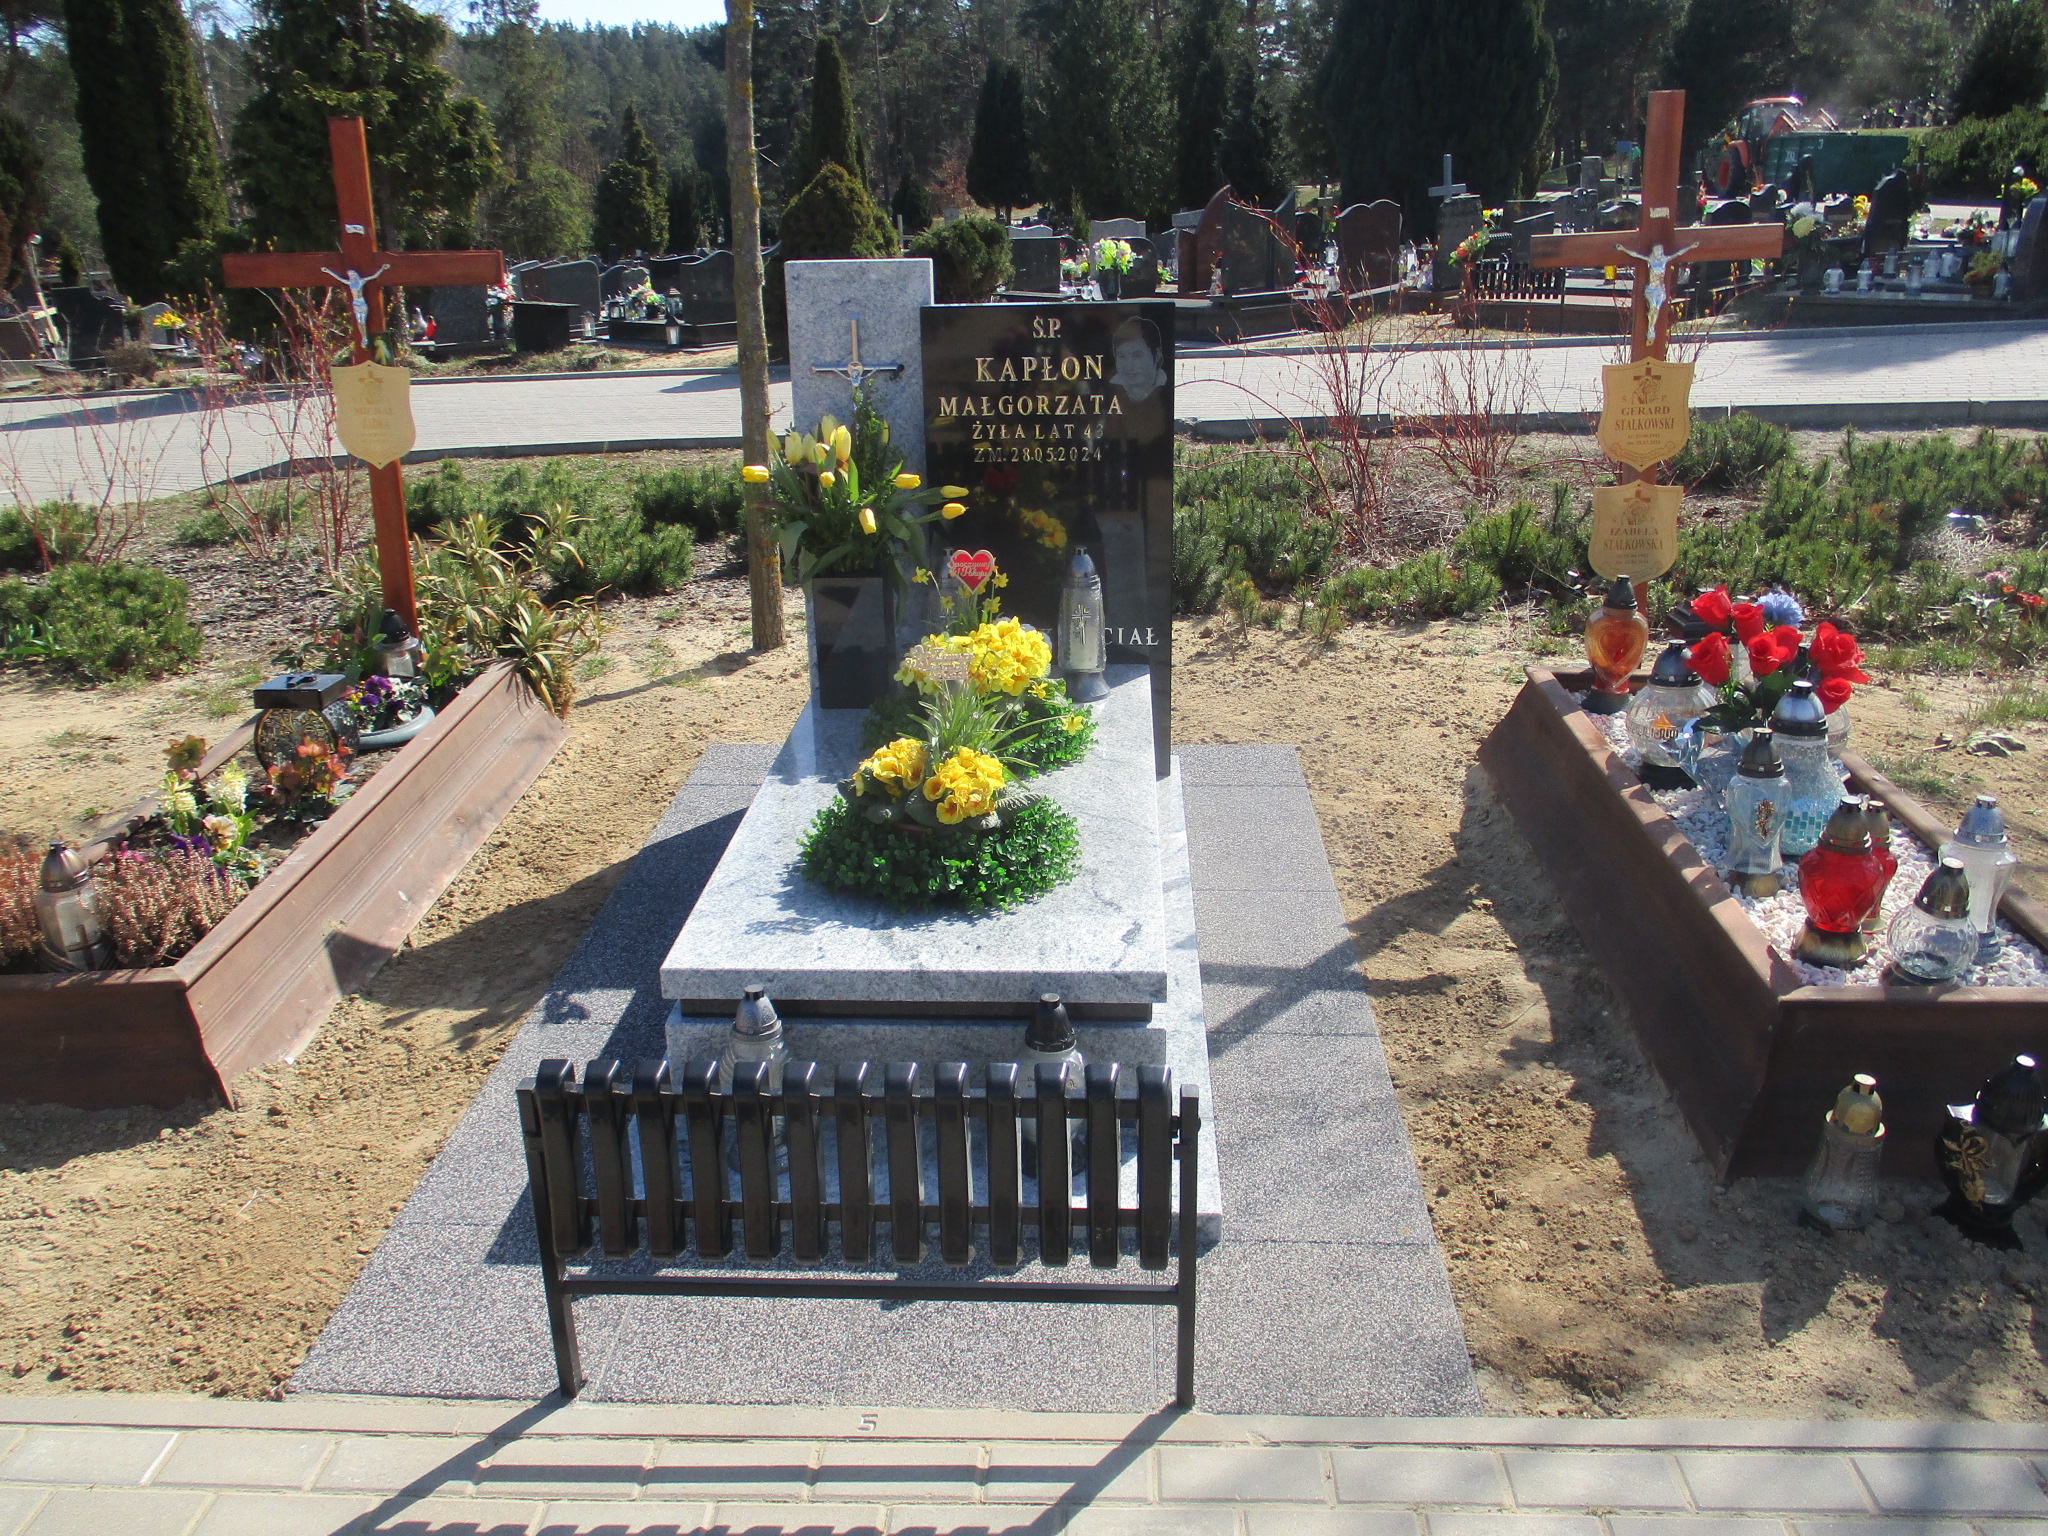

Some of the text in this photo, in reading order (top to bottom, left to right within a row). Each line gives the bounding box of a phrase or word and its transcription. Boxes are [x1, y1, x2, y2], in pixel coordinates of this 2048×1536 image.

[975, 355, 1104, 382] KAPŁON
[938, 395, 1123, 417] MAŁGORZATA
[1621, 405, 1671, 416] GERARD
[972, 420, 1026, 440] ŻYŁA
[1034, 423, 1075, 440] LAT
[1614, 418, 1675, 431] STALKOWSKI
[1610, 527, 1660, 537] IZABELA
[857, 1413, 879, 1432] 5
